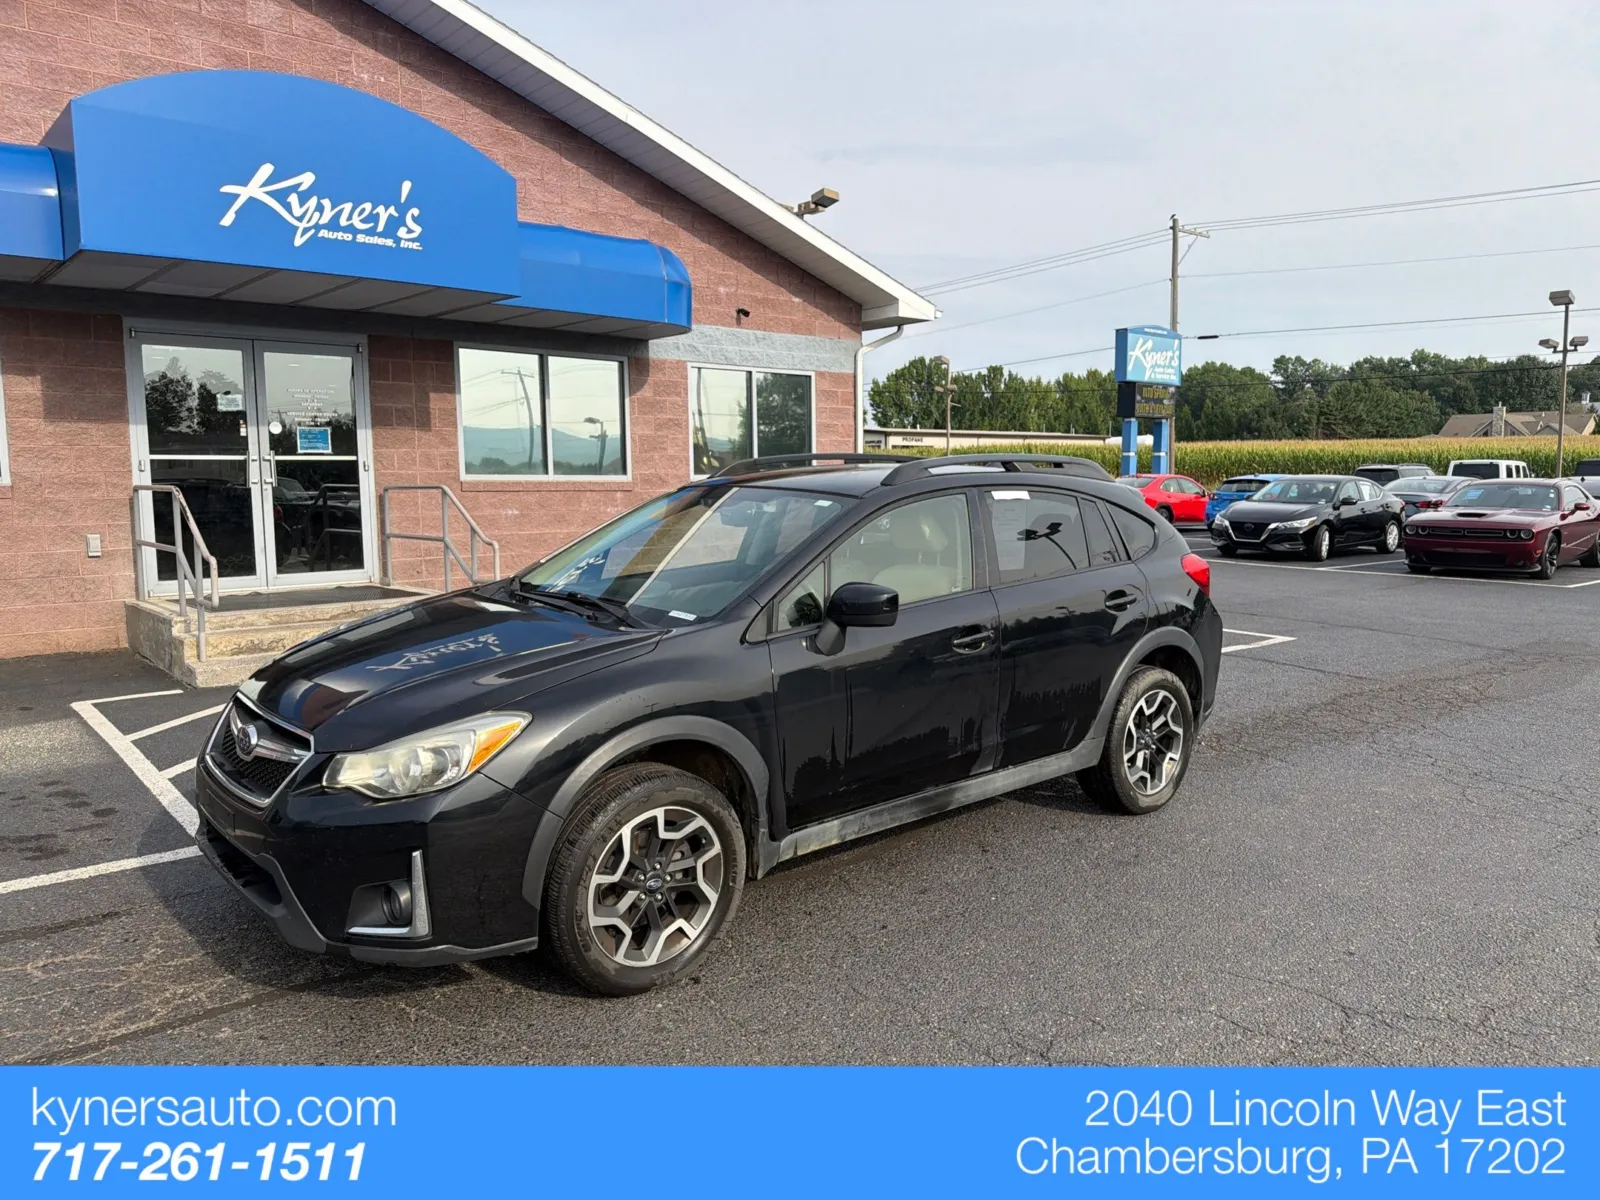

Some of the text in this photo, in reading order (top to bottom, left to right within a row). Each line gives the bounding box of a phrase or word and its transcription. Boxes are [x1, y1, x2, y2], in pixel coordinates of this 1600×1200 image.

[219, 162, 422, 248] Kyner's
[317, 228, 423, 250] Auto Sales, Inc.
[1128, 337, 1180, 381] Kyner's
